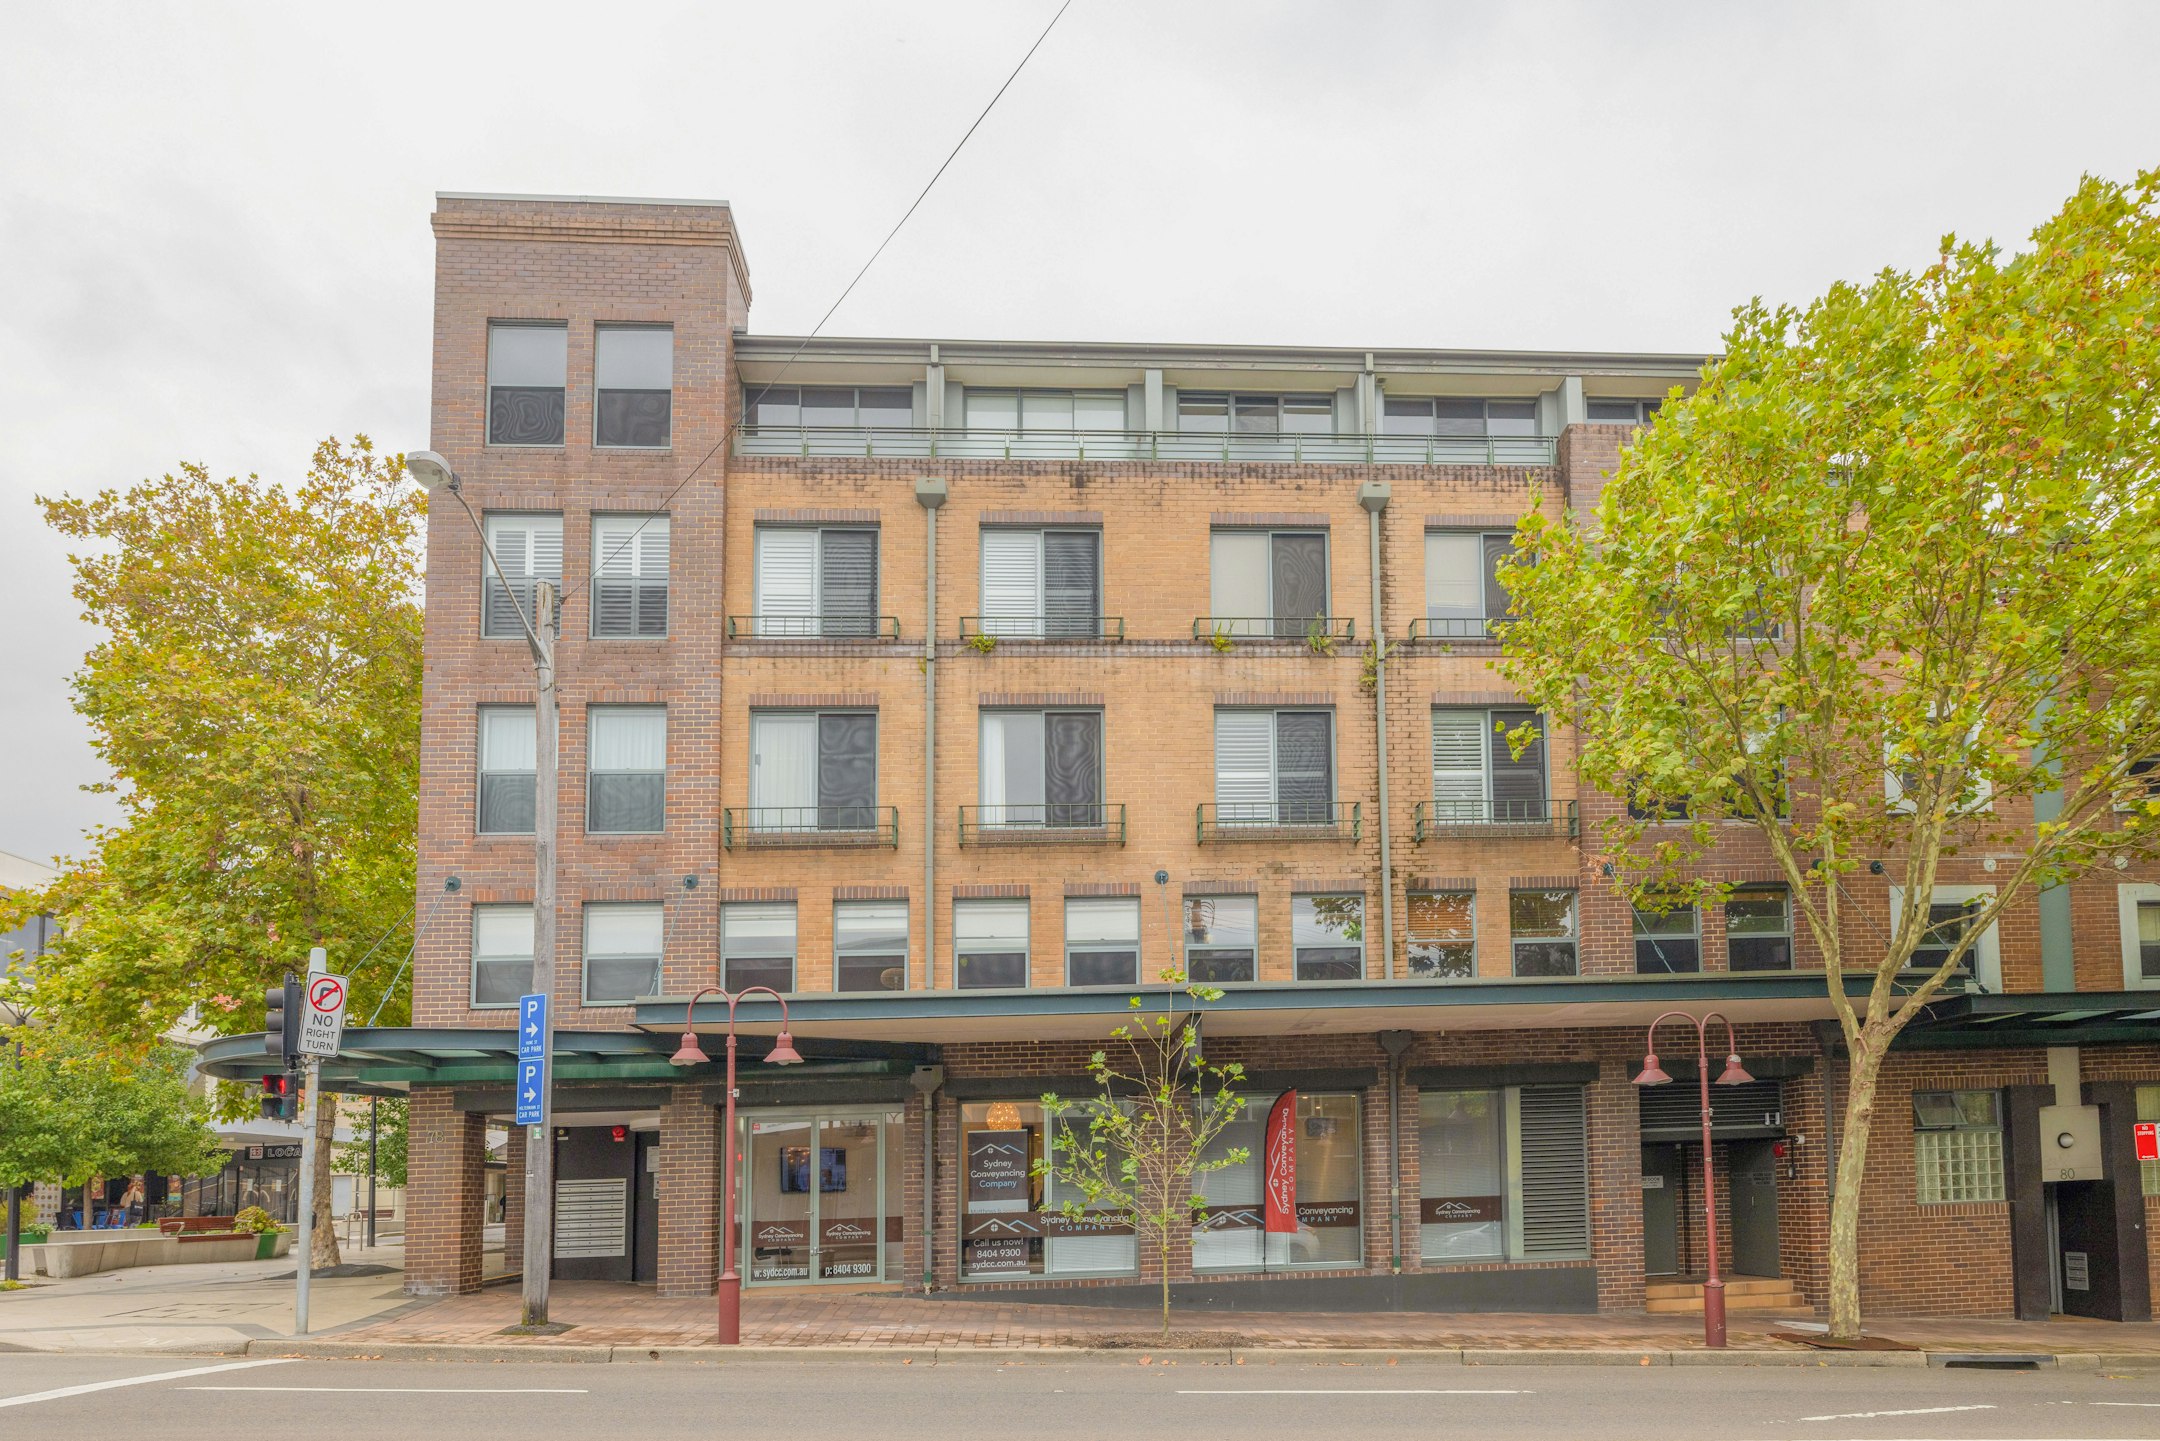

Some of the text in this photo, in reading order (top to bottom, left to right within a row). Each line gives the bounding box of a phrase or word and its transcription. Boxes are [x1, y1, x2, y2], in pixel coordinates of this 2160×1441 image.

[527, 1001, 538, 1019] P
[312, 1013, 333, 1027] NO
[306, 1028, 336, 1040] RIGHT
[306, 1039, 334, 1051] TURN
[521, 1045, 542, 1054] CAR PARK
[525, 1065, 536, 1084] P
[519, 1110, 540, 1119] CAR PARK
[983, 1159, 1012, 1169] Sydney
[1280, 1107, 1290, 1214] Sydney Conveyancing
[970, 1169, 1026, 1179] Conveyancing
[2060, 1168, 2075, 1180] 80
[979, 1179, 1017, 1189] Company
[1299, 1206, 1354, 1216] Conveyancing
[1040, 1216, 1070, 1226] Sydney
[973, 1239, 990, 1247] Call
[1003, 1237, 1024, 1246] now!
[976, 1248, 1021, 1259] 8404 9300
[825, 1263, 871, 1276] p: 8404 9300
[972, 1260, 1026, 1270] sydcc.com.au
[753, 1267, 808, 1279] w: sydcc.com.au
